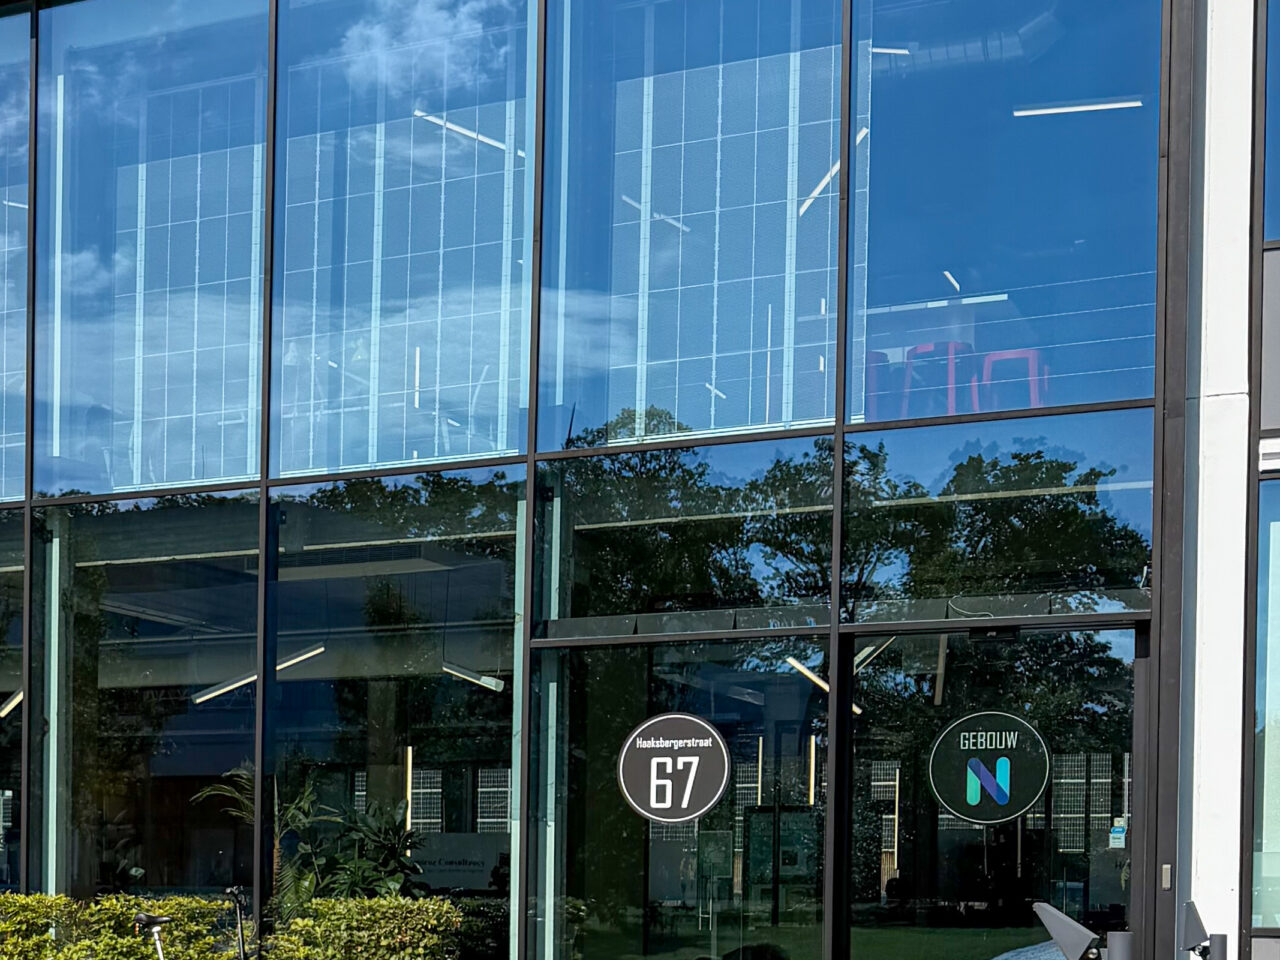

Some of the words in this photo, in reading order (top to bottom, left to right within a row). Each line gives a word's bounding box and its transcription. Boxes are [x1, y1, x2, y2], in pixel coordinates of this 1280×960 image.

[636, 737, 713, 750] Haaksbergerstraat
[960, 731, 1018, 749] GEBOUW
[649, 756, 700, 809] 67
[966, 756, 1011, 806] N
